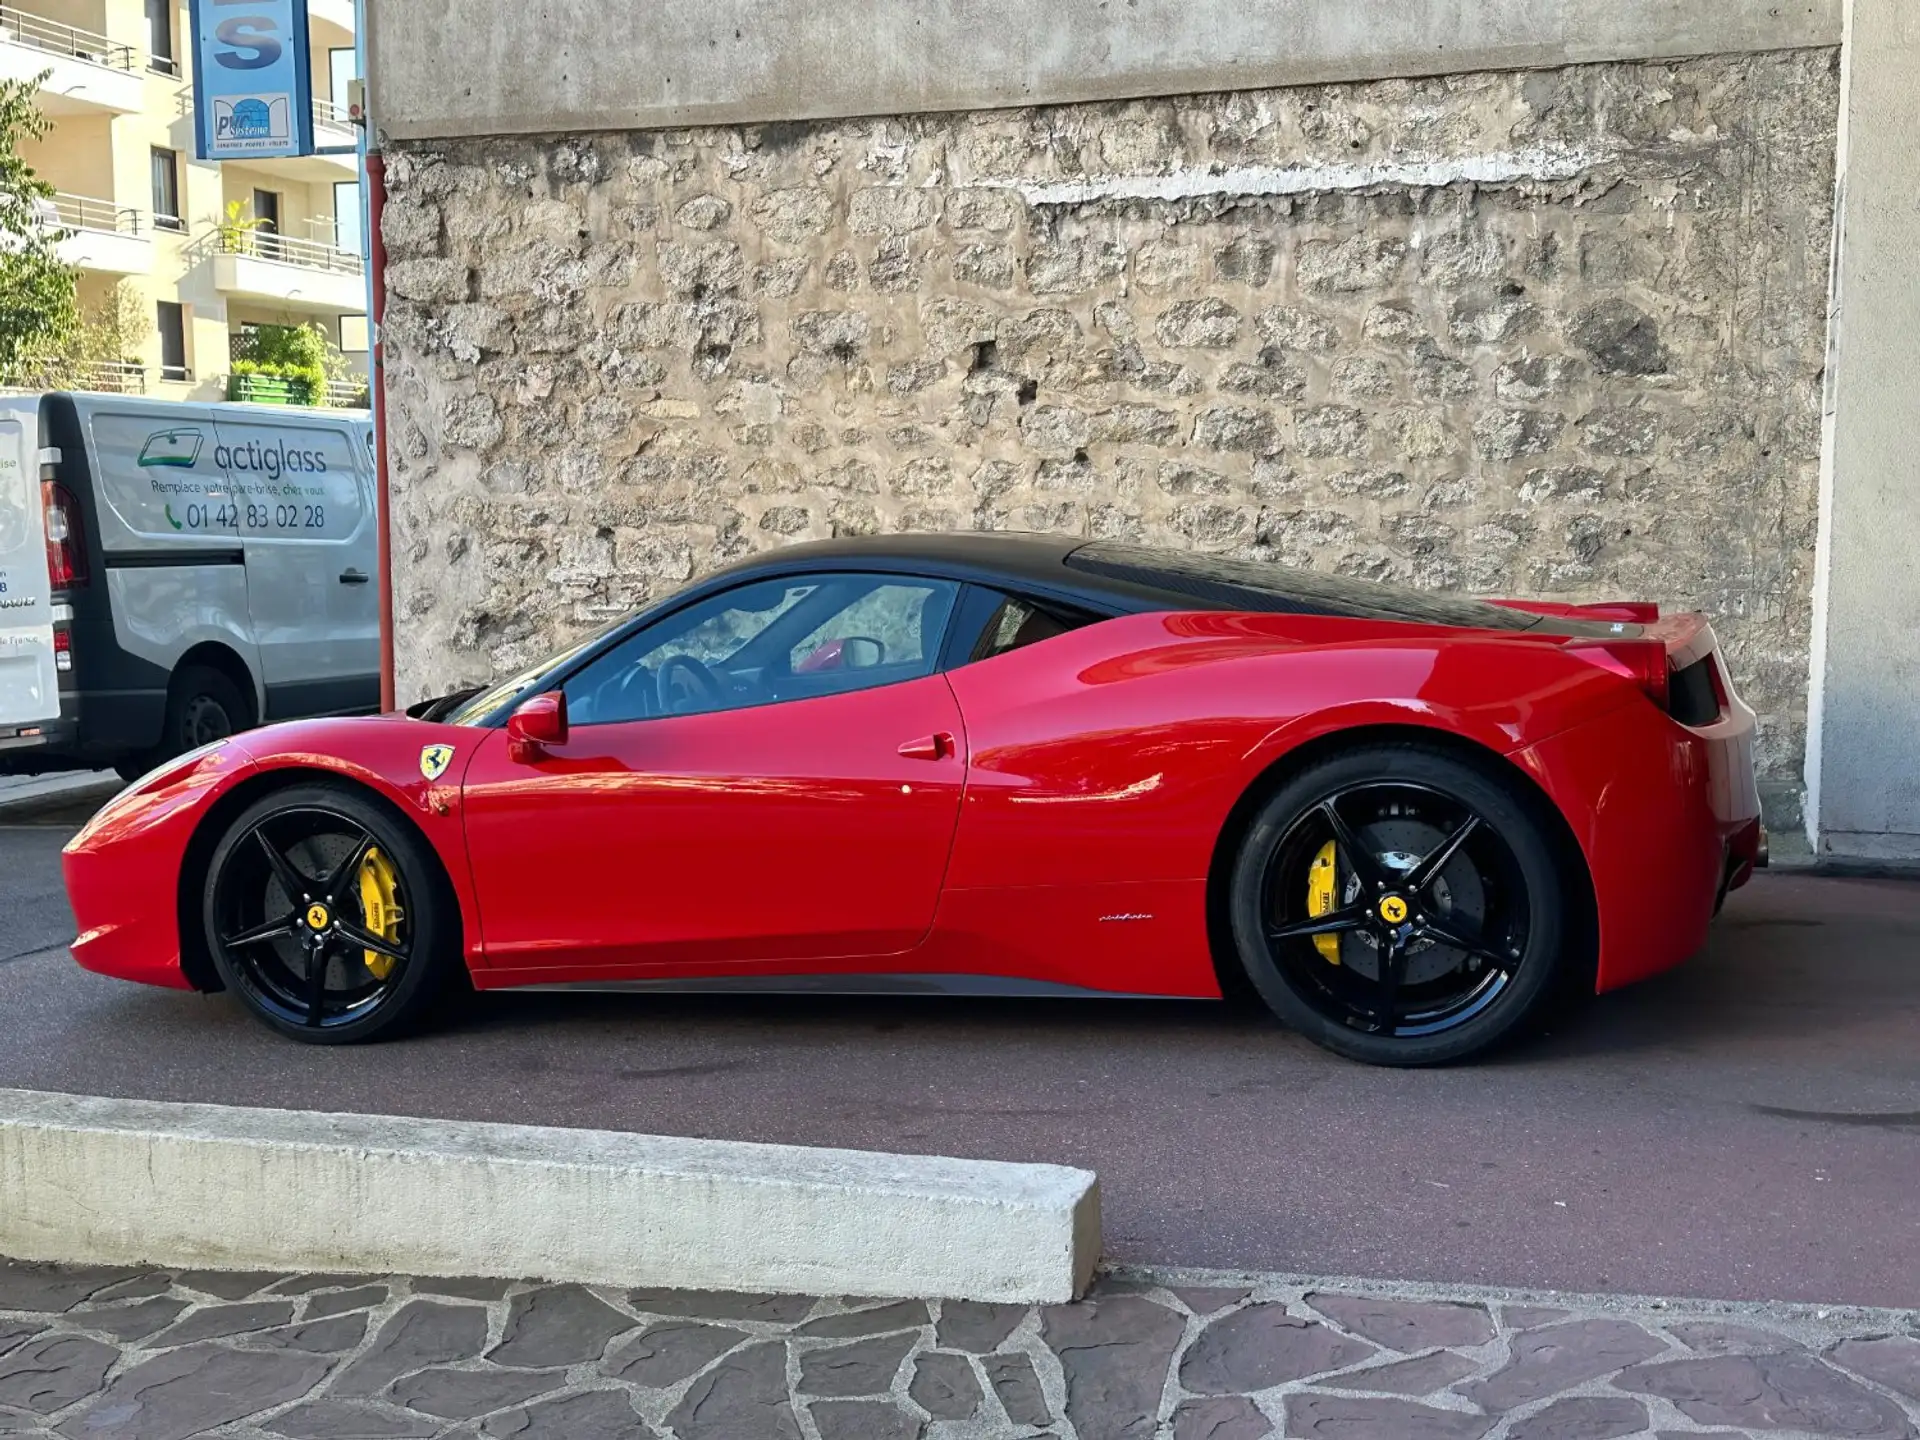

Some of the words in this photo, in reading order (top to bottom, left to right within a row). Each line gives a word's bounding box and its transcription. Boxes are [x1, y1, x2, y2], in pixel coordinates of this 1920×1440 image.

[213, 0, 282, 70] S
[214, 438, 327, 480] actiglass
[151, 479, 201, 494] Remplace
[203, 483, 230, 494] votre
[187, 503, 208, 528] 01
[216, 504, 239, 528] 42
[246, 504, 268, 528] 83
[276, 504, 298, 528] 02
[305, 504, 325, 528] 28
